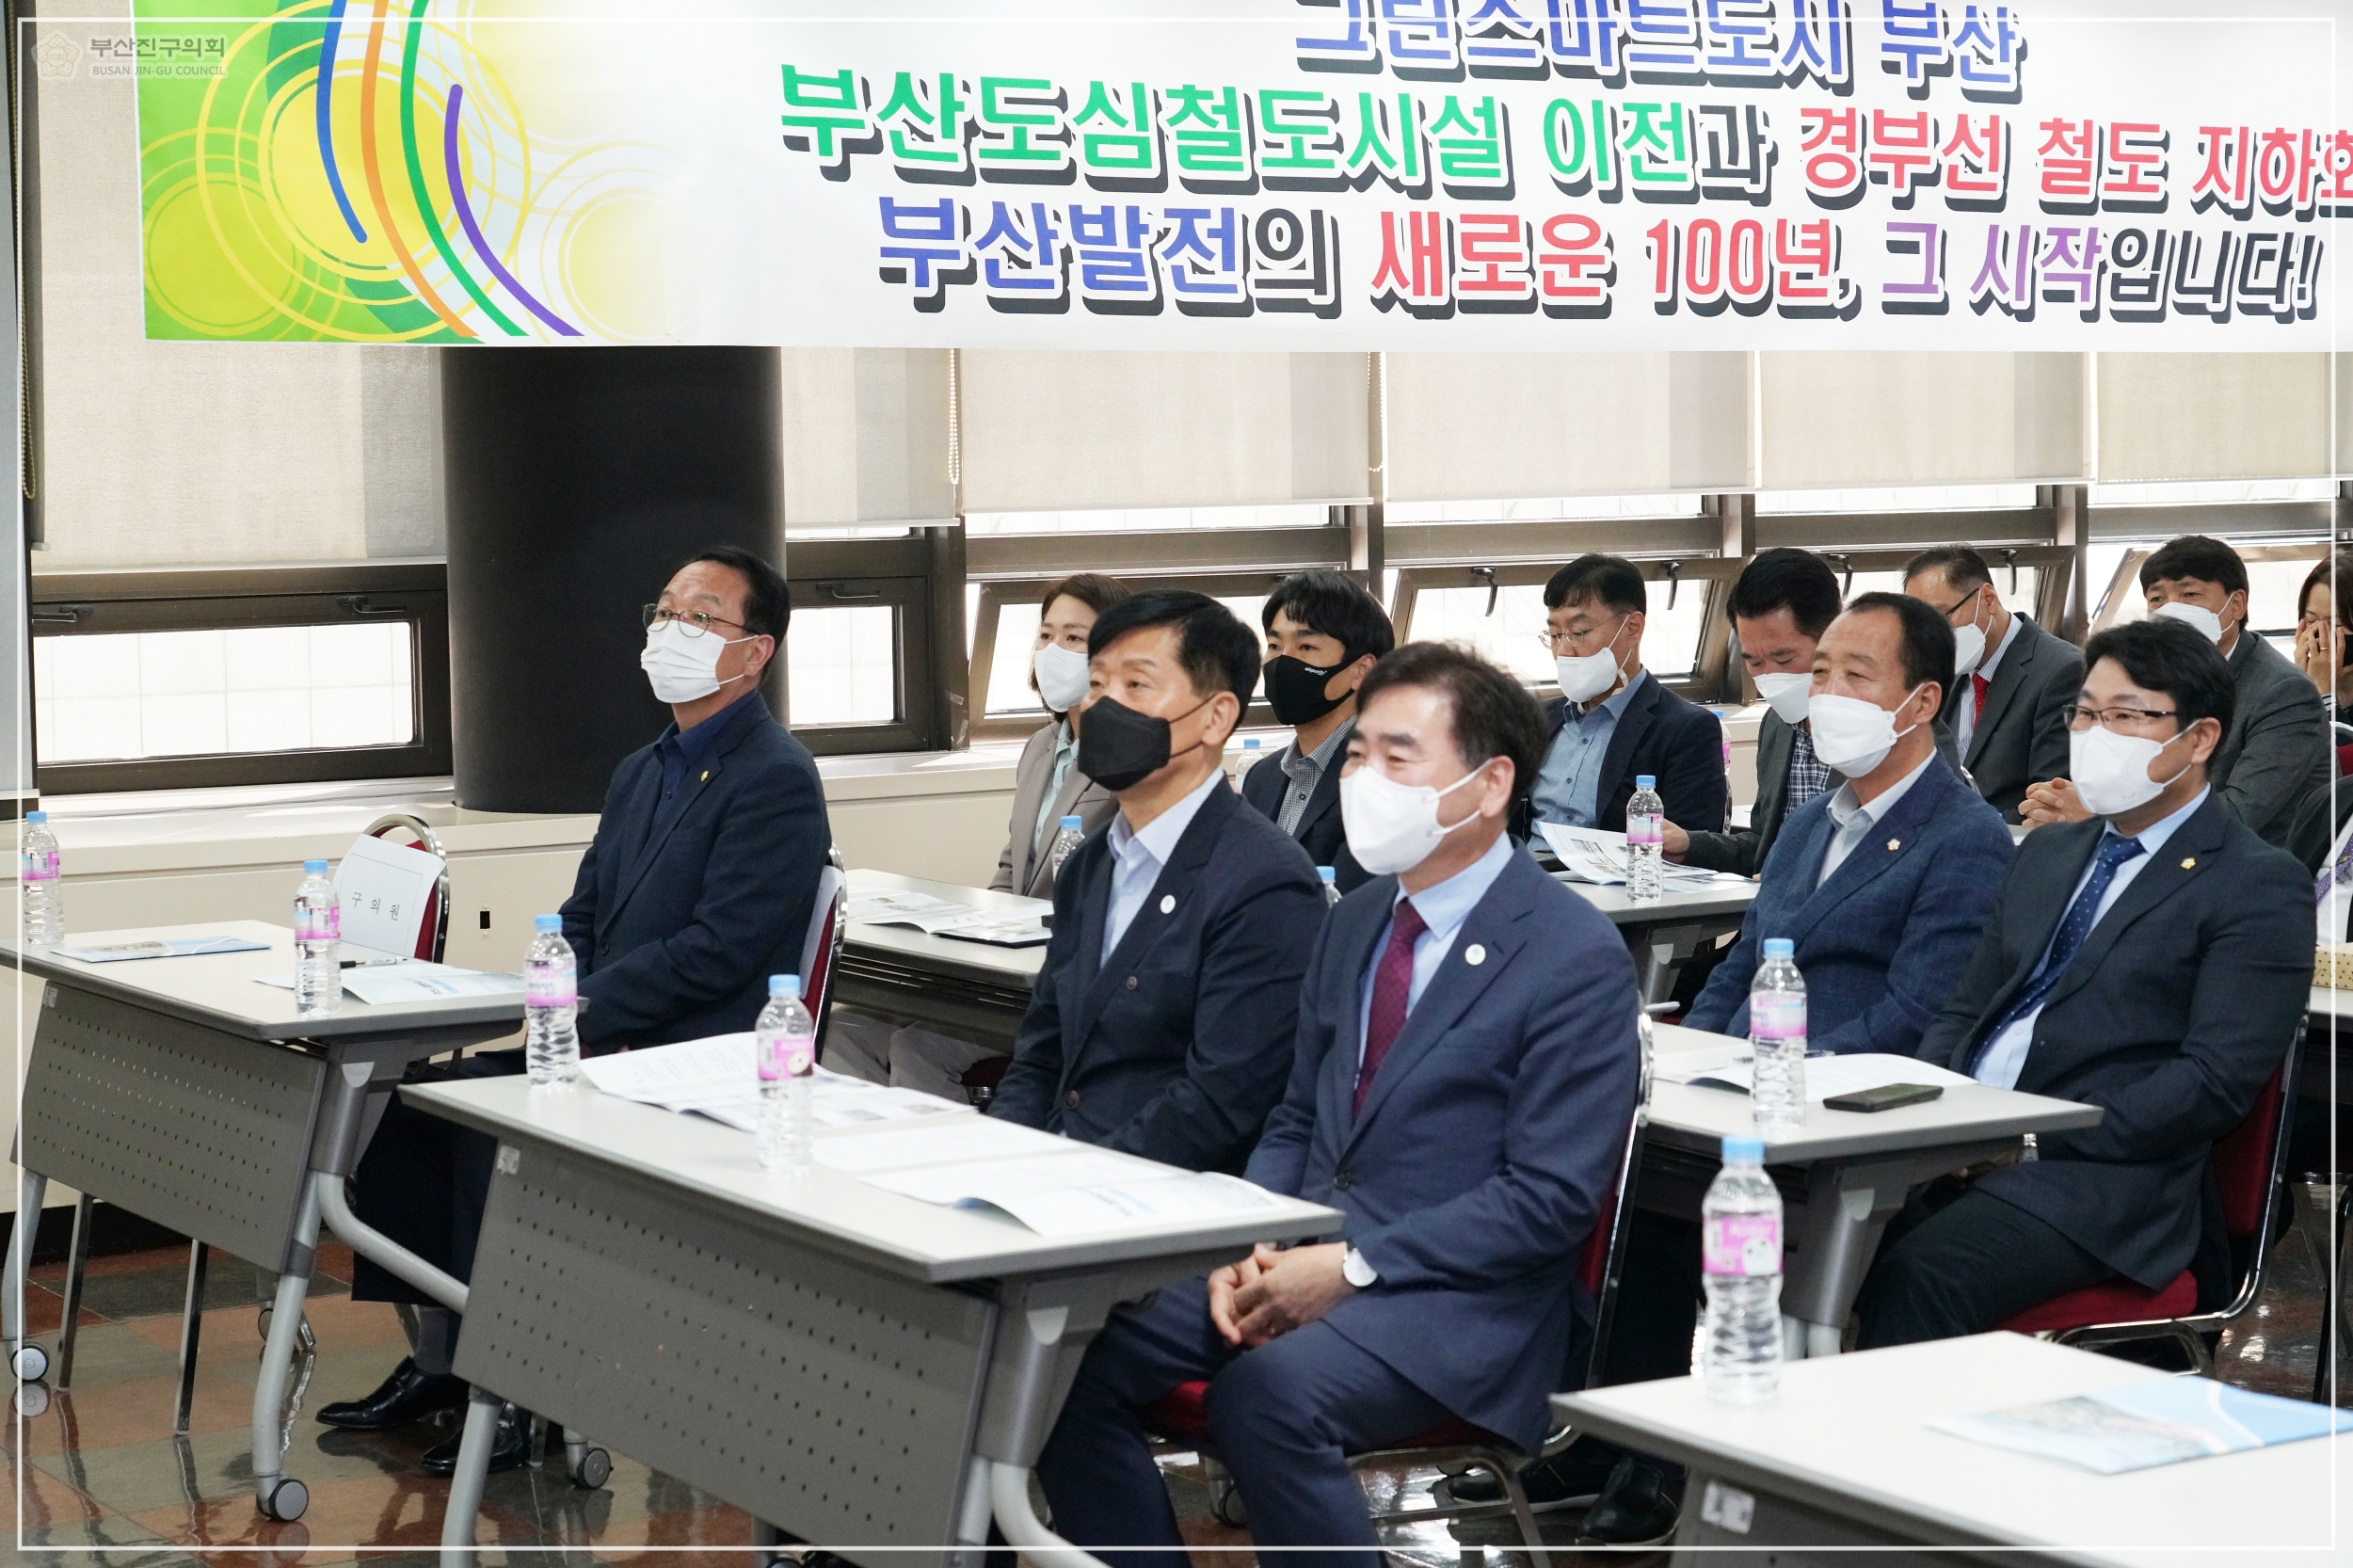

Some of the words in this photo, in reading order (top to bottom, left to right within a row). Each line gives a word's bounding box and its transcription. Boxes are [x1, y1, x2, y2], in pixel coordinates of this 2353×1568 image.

[1881, 0, 2016, 84] 부산
[780, 63, 1503, 179] 부산도심철도시설
[1542, 98, 1769, 191] 이전과
[1800, 106, 2001, 193] 경부선
[2037, 118, 2161, 196] 철도
[878, 196, 1325, 297] 부산발전의
[1370, 210, 1606, 298] 새로운
[1645, 217, 1852, 303] 100년,
[1882, 222, 1939, 296] 그
[1970, 225, 2317, 304] 시작입니다!
